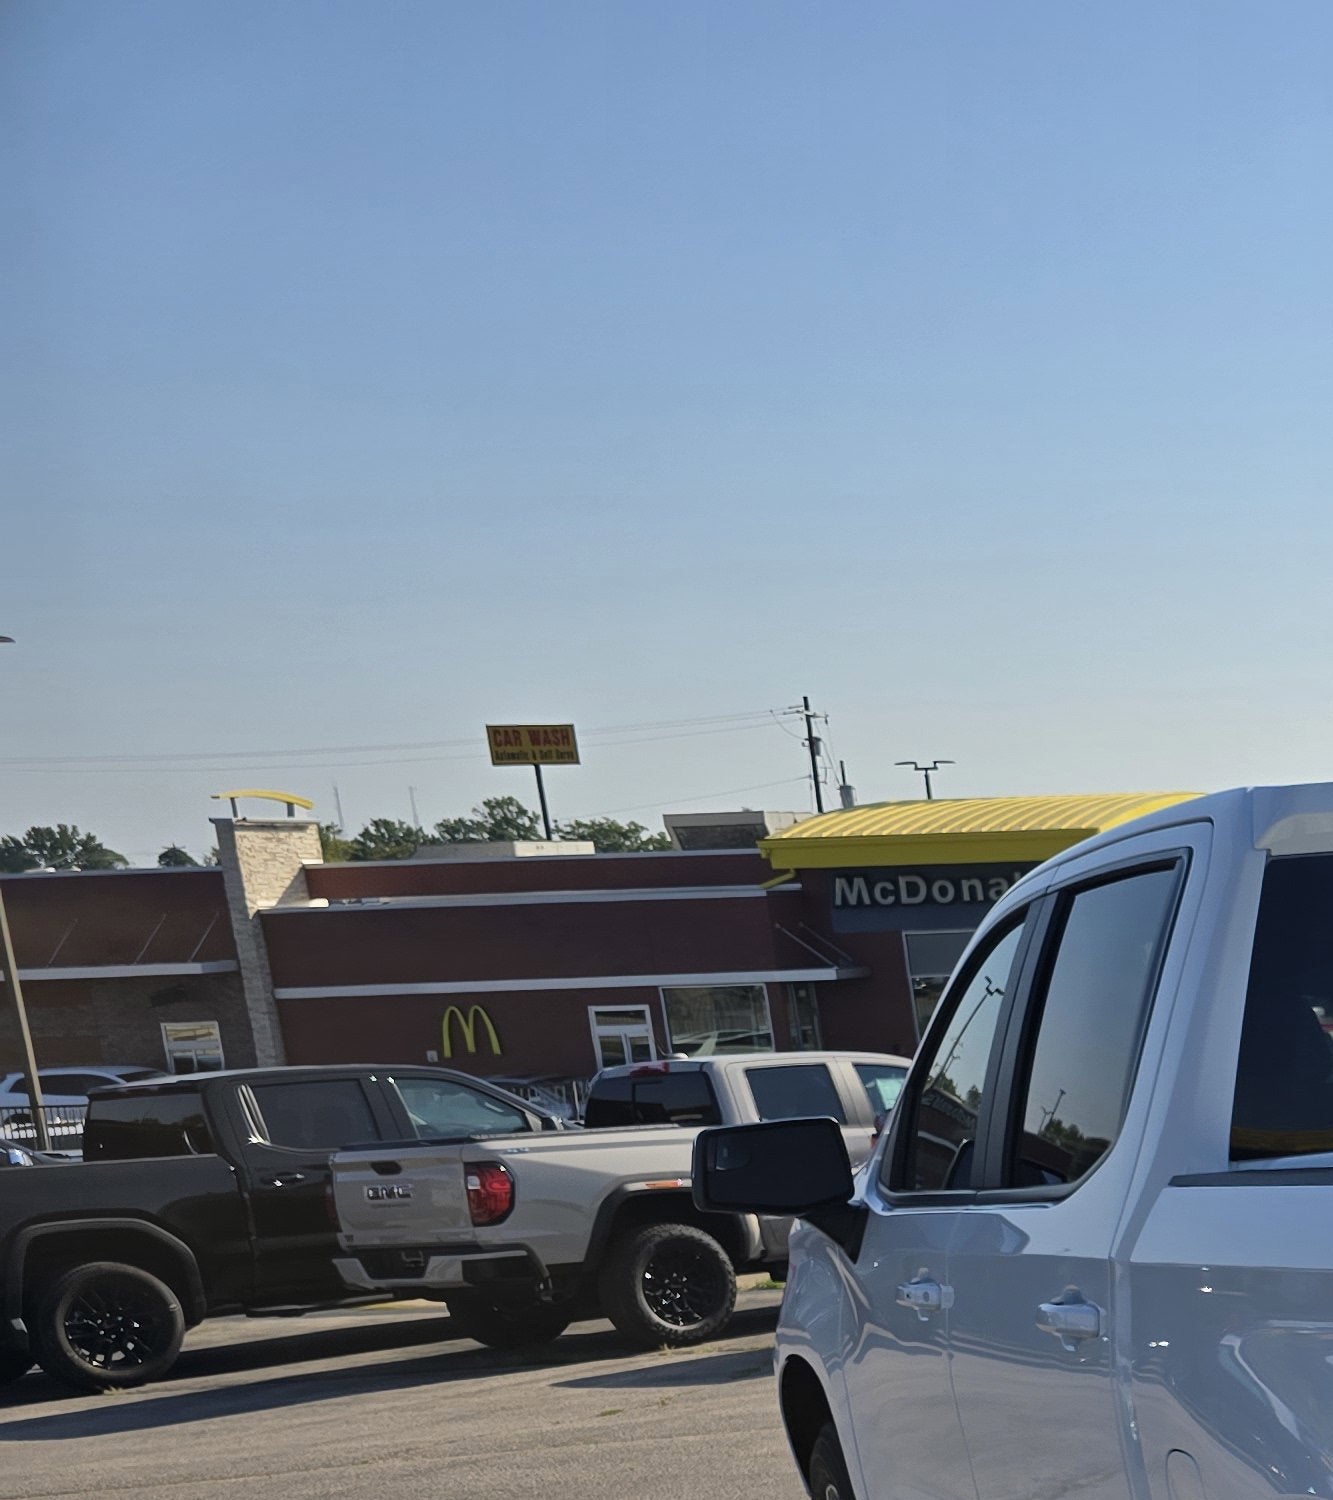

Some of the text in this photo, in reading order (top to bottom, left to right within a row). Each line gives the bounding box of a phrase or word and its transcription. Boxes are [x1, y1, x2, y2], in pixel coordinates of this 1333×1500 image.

[492, 728, 571, 747] CAR WASH
[835, 872, 1022, 906] McDona
[364, 1183, 414, 1201] GMC
